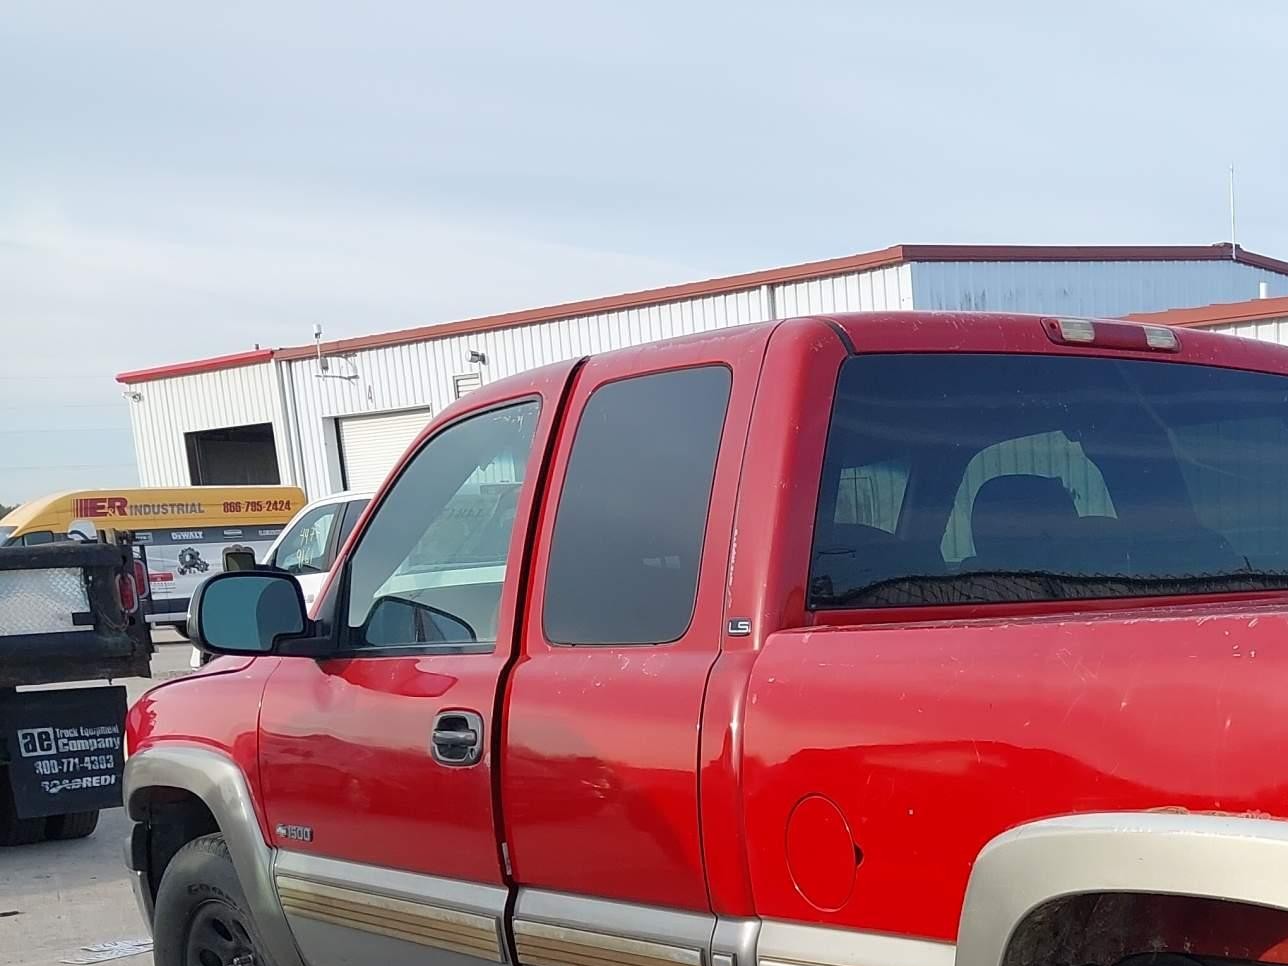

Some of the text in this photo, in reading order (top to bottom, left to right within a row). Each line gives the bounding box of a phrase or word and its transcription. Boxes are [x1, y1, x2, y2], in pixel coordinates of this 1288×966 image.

[80, 496, 205, 518] E&R INDUSTRIAL
[728, 620, 750, 634] LS
[55, 728, 79, 738] Truck
[58, 737, 120, 752] Company
[287, 824, 311, 841] 1500
